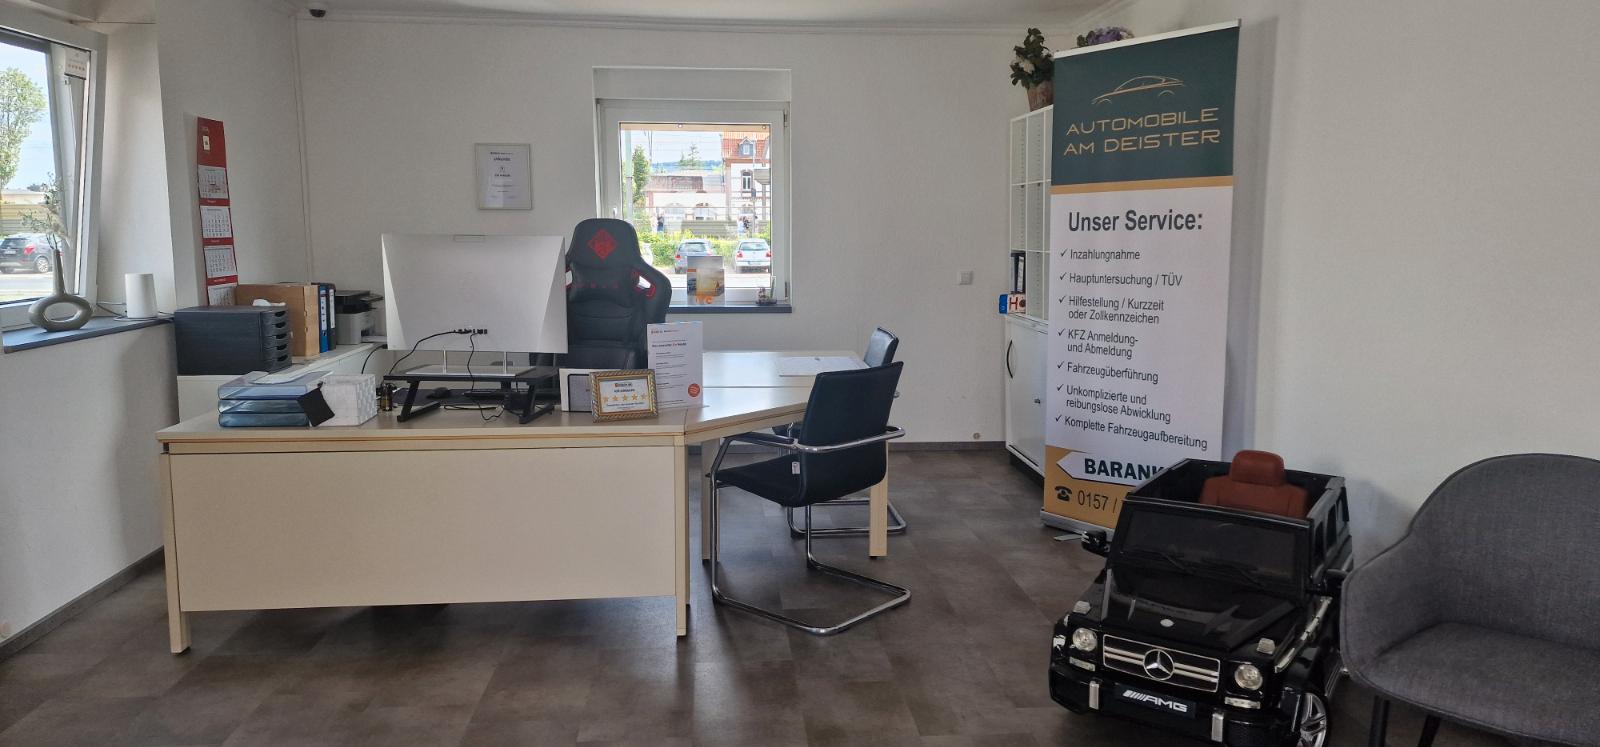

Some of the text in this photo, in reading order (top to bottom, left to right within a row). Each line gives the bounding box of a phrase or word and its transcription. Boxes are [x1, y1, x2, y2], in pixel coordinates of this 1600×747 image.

[1066, 107, 1219, 136] AUTOMOBILE
[1063, 129, 1221, 156] AM DEISTER
[1068, 209, 1203, 232] Unser Service:
[1070, 249, 1141, 262] Inzahlungnahme
[1069, 272, 1153, 288] Hauptuntersuchung
[1162, 272, 1183, 287] TÜV
[1068, 295, 1120, 311] Hilfestellung
[1128, 298, 1165, 312] Kurzzeit
[1068, 309, 1160, 325] oder Zollkennzeichen
[1068, 328, 1139, 347] KFZ Anmeldung-
[1067, 343, 1133, 360] und Abmeldung
[1067, 361, 1159, 385] Fahrzeugüberführung
[1066, 384, 1147, 406] Unkomplizierte und
[1066, 398, 1171, 425] reibungslose Abwicklung
[1064, 415, 1208, 451] Komplette Fahrzeugaufbereitung
[1077, 489, 1109, 511] 0157
[1142, 695, 1188, 713] AMG
